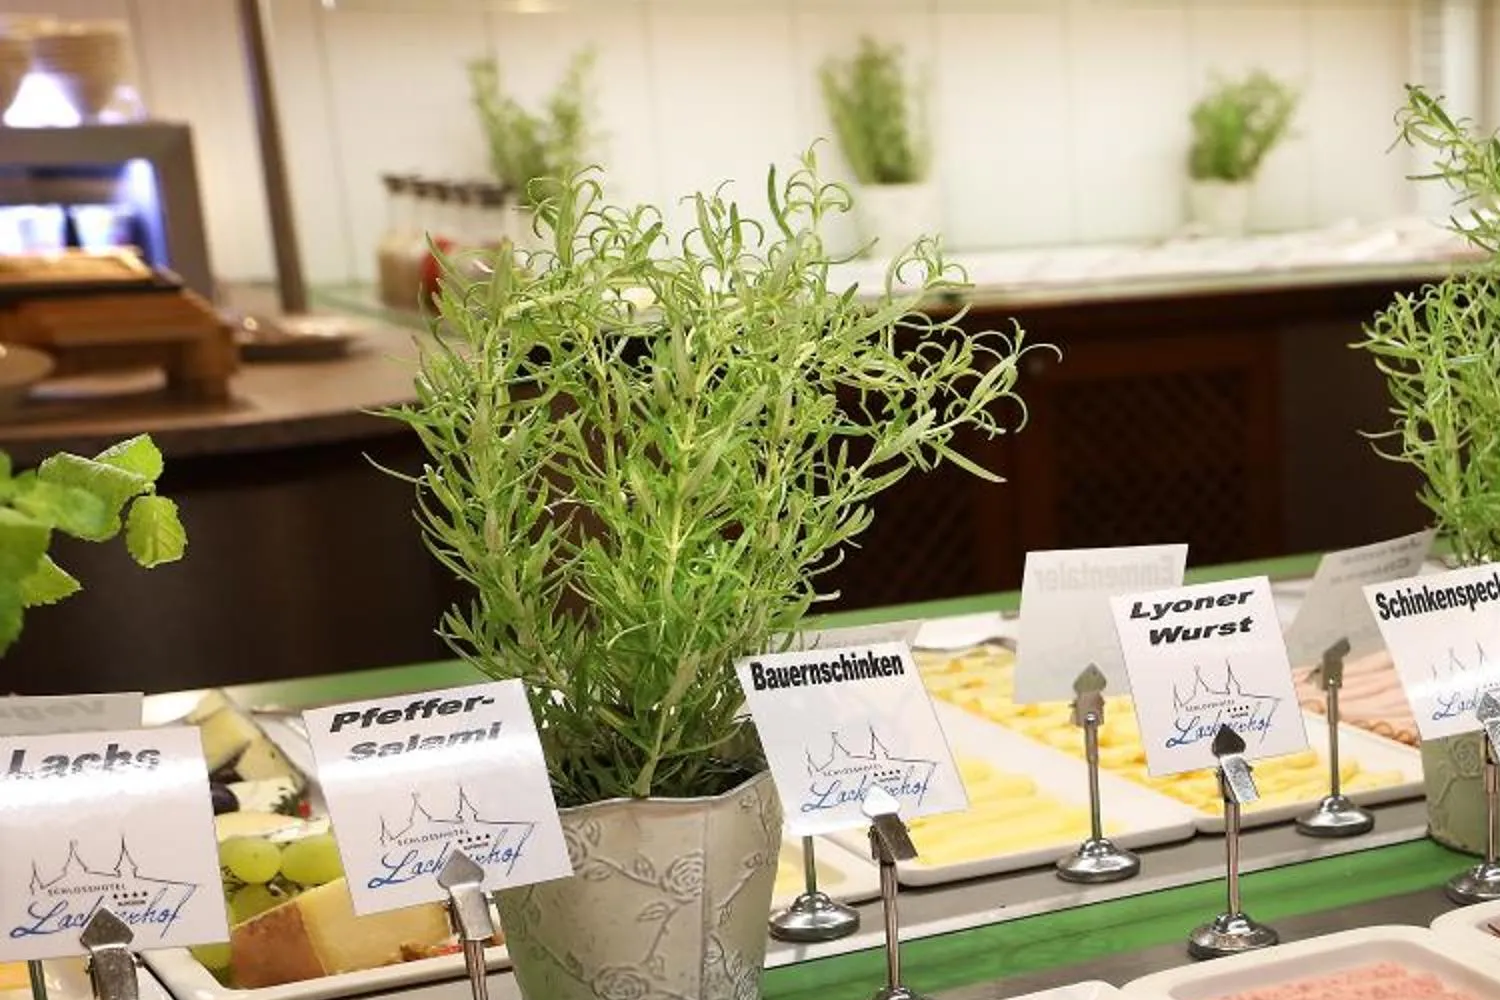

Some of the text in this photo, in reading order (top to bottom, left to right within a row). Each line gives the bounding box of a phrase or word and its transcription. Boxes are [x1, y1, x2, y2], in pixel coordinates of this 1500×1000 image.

[1130, 590, 1254, 620] Lyoner
[1149, 616, 1254, 646] Wurst
[750, 651, 905, 691] Bauernschinken
[329, 695, 495, 733] Pfeffer-
[348, 722, 502, 761] Salami
[7, 743, 161, 780] Lachs
